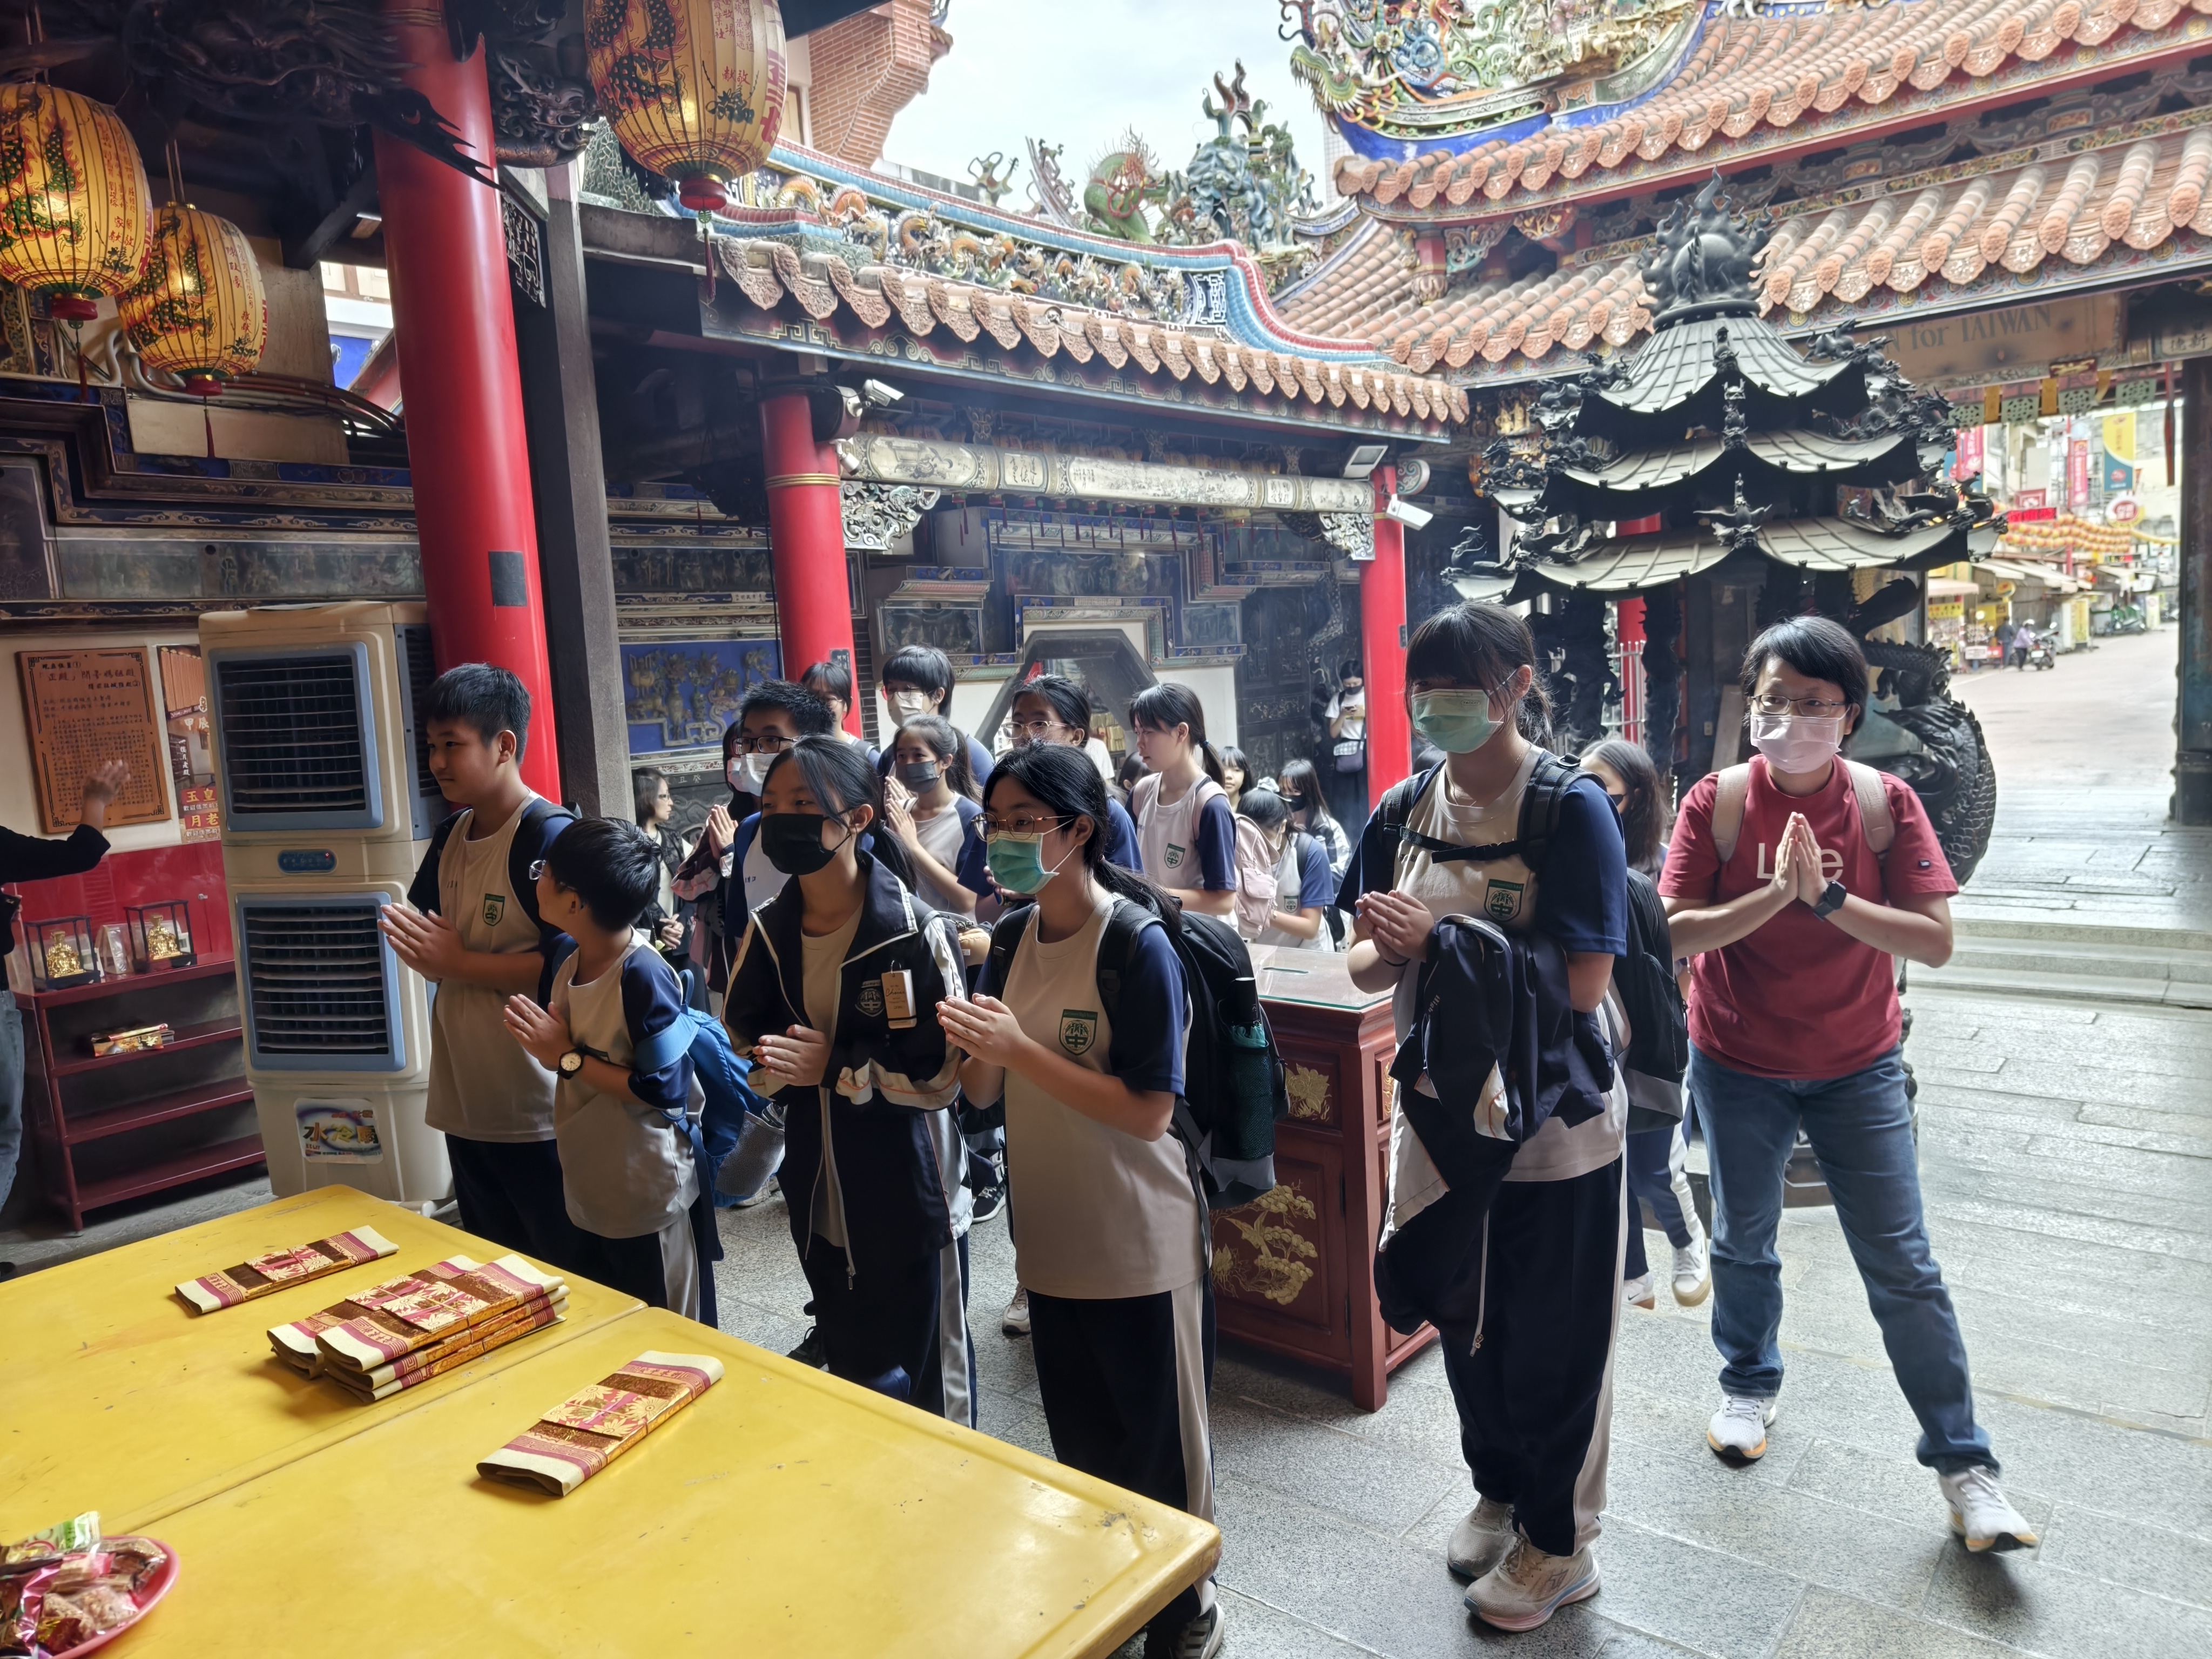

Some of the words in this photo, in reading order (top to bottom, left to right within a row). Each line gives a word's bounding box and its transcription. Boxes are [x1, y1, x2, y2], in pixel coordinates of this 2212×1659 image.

[1908, 324, 1950, 350] for
[1957, 304, 2052, 342] TAIWAN
[186, 827, 221, 838] 歡迎信眾前
[1757, 842, 1844, 882] Le
